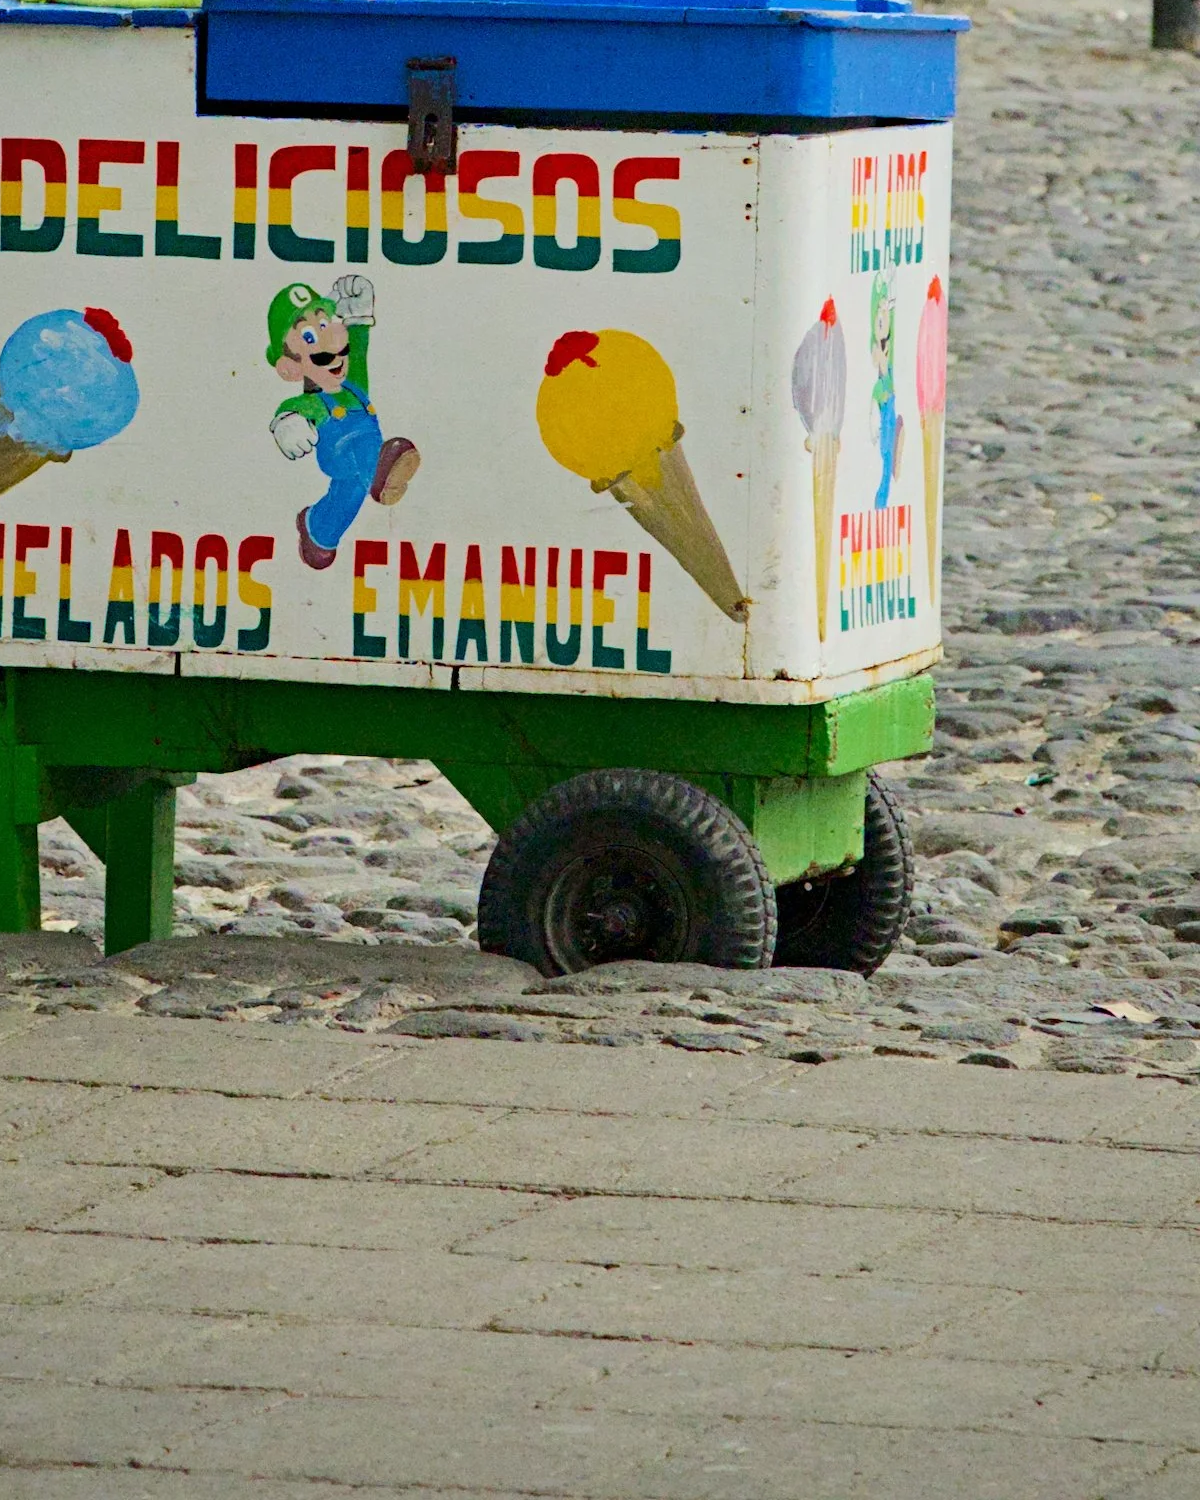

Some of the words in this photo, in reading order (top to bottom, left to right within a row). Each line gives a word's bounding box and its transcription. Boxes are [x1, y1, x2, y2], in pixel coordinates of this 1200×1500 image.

[0, 138, 682, 273] DELICIOSOS
[851, 151, 927, 274] HELADOS
[352, 540, 673, 674] EMANUEL
[840, 504, 915, 632] EMANUEL
